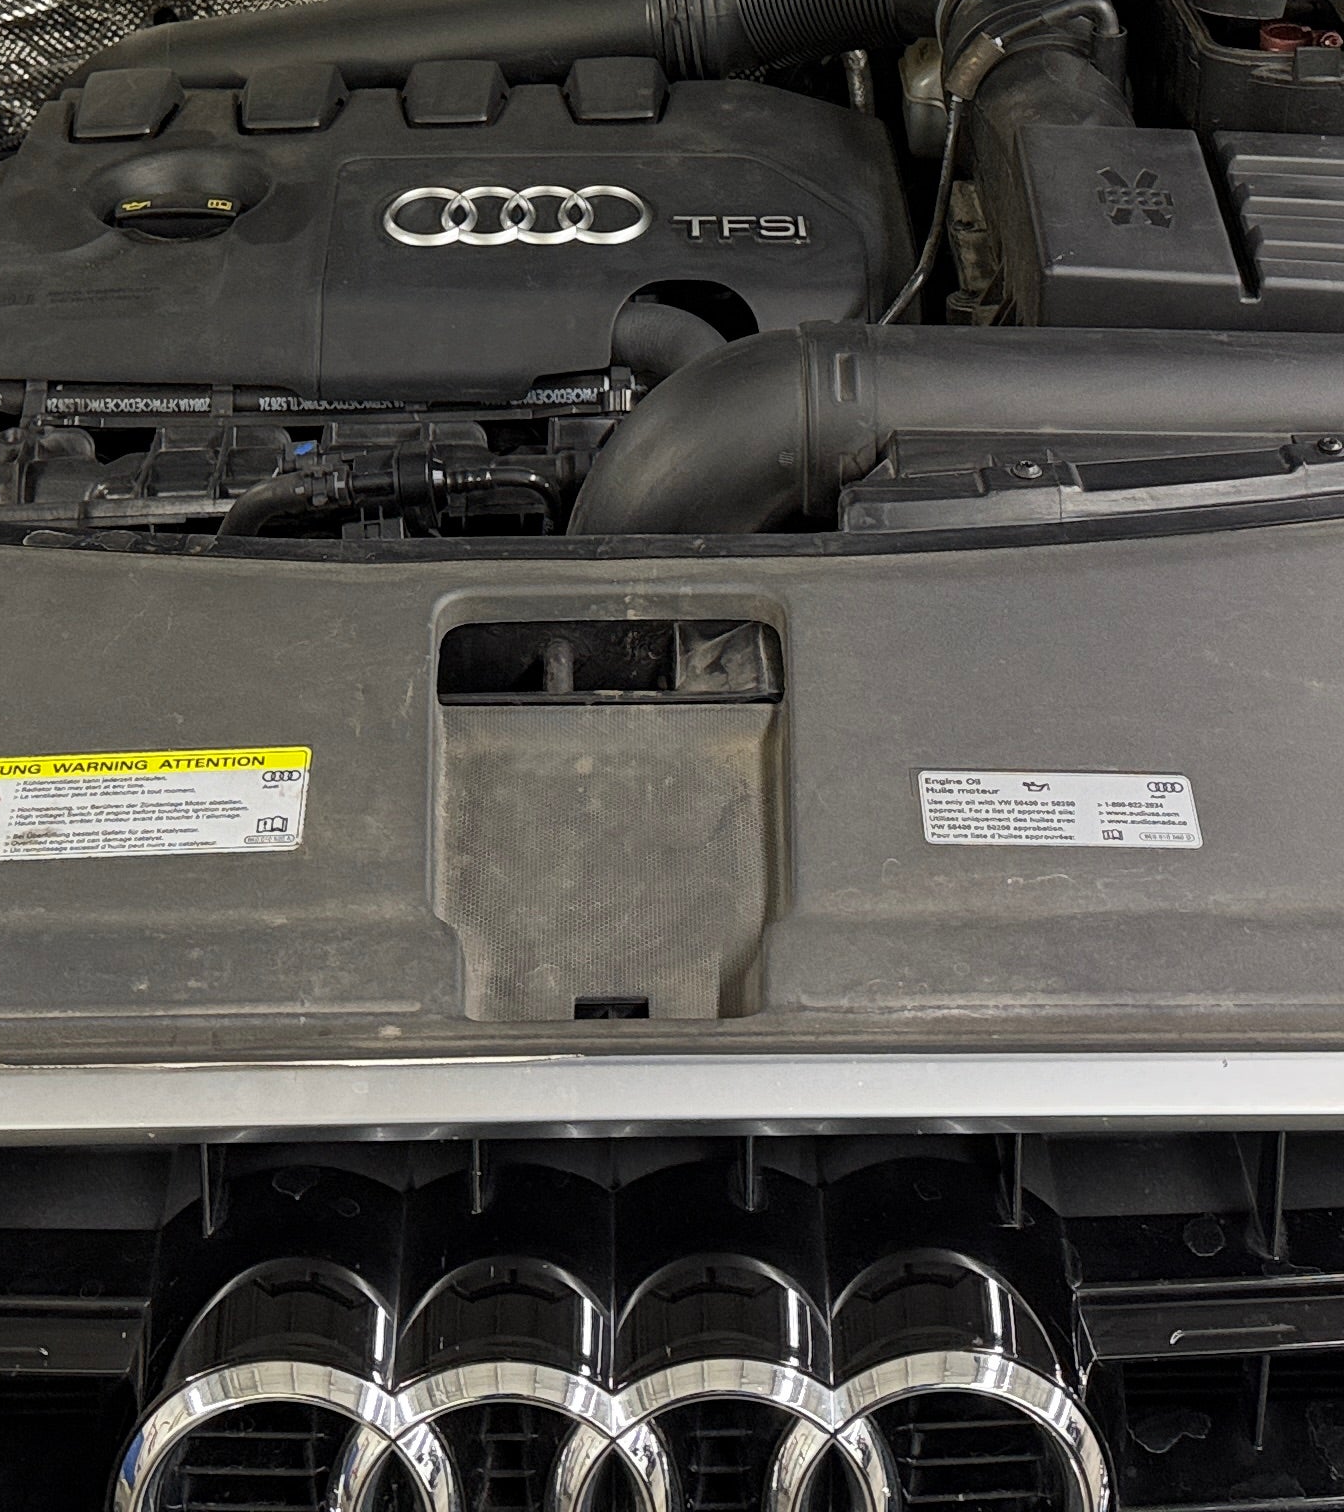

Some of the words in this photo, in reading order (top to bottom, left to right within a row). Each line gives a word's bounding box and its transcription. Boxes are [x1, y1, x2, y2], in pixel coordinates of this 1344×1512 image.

[673, 216, 806, 236] TFSI
[53, 760, 148, 774] WARNING
[160, 756, 266, 769] ATTENTION
